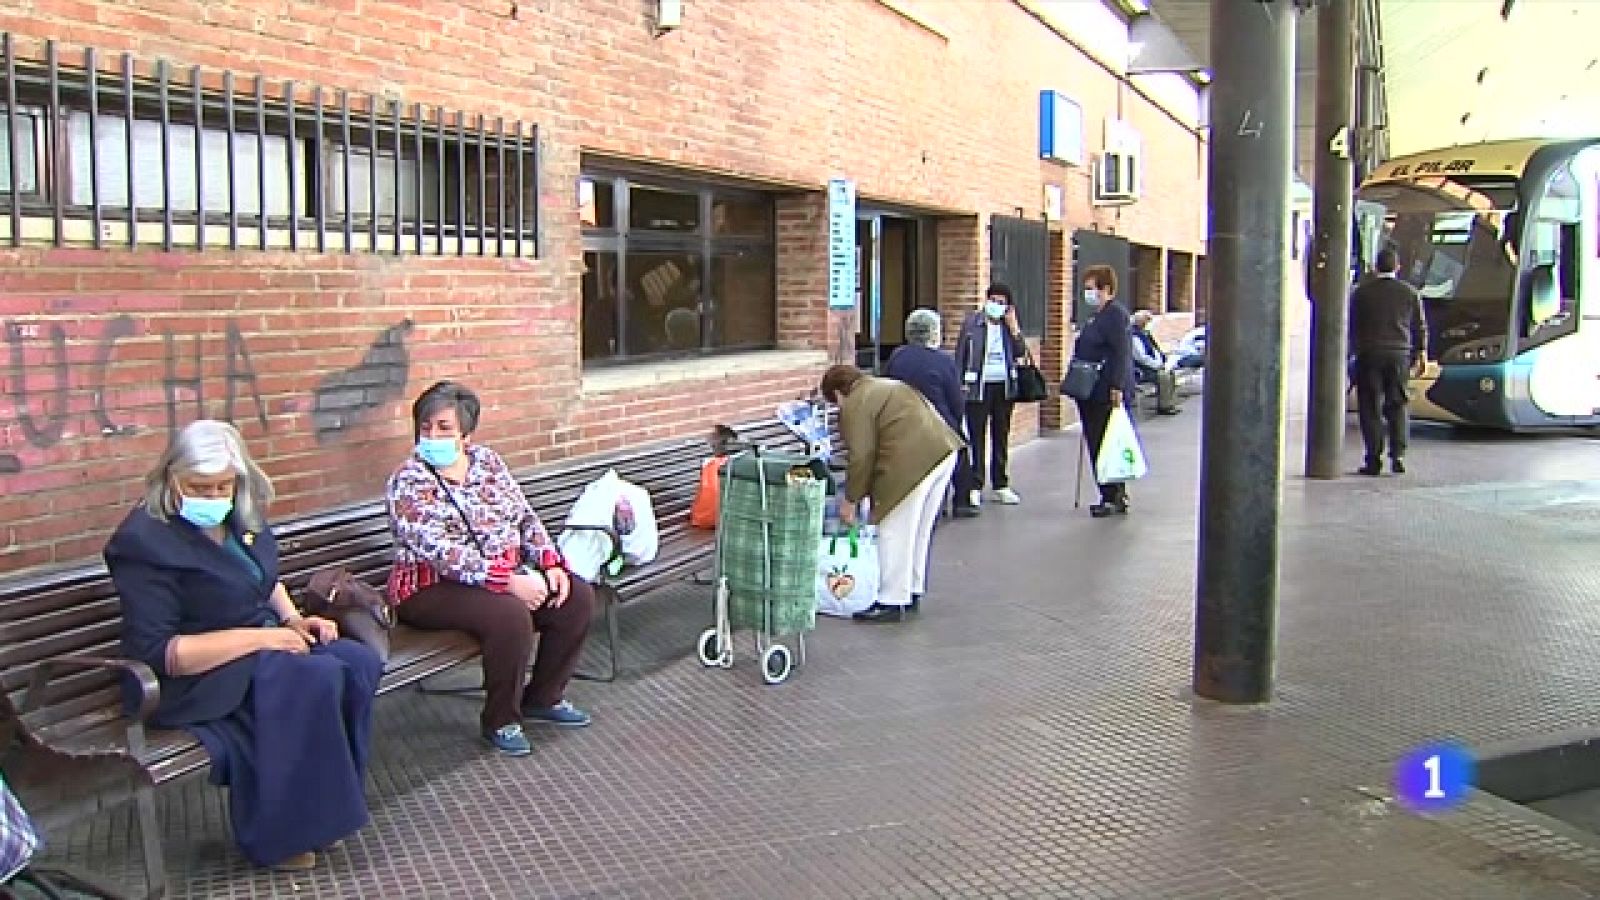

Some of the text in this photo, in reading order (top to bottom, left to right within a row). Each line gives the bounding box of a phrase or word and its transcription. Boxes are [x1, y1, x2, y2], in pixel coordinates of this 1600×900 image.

[1329, 126, 1349, 158] 4
[1414, 159, 1475, 173] PILAR
[0, 314, 269, 472] UCHA
